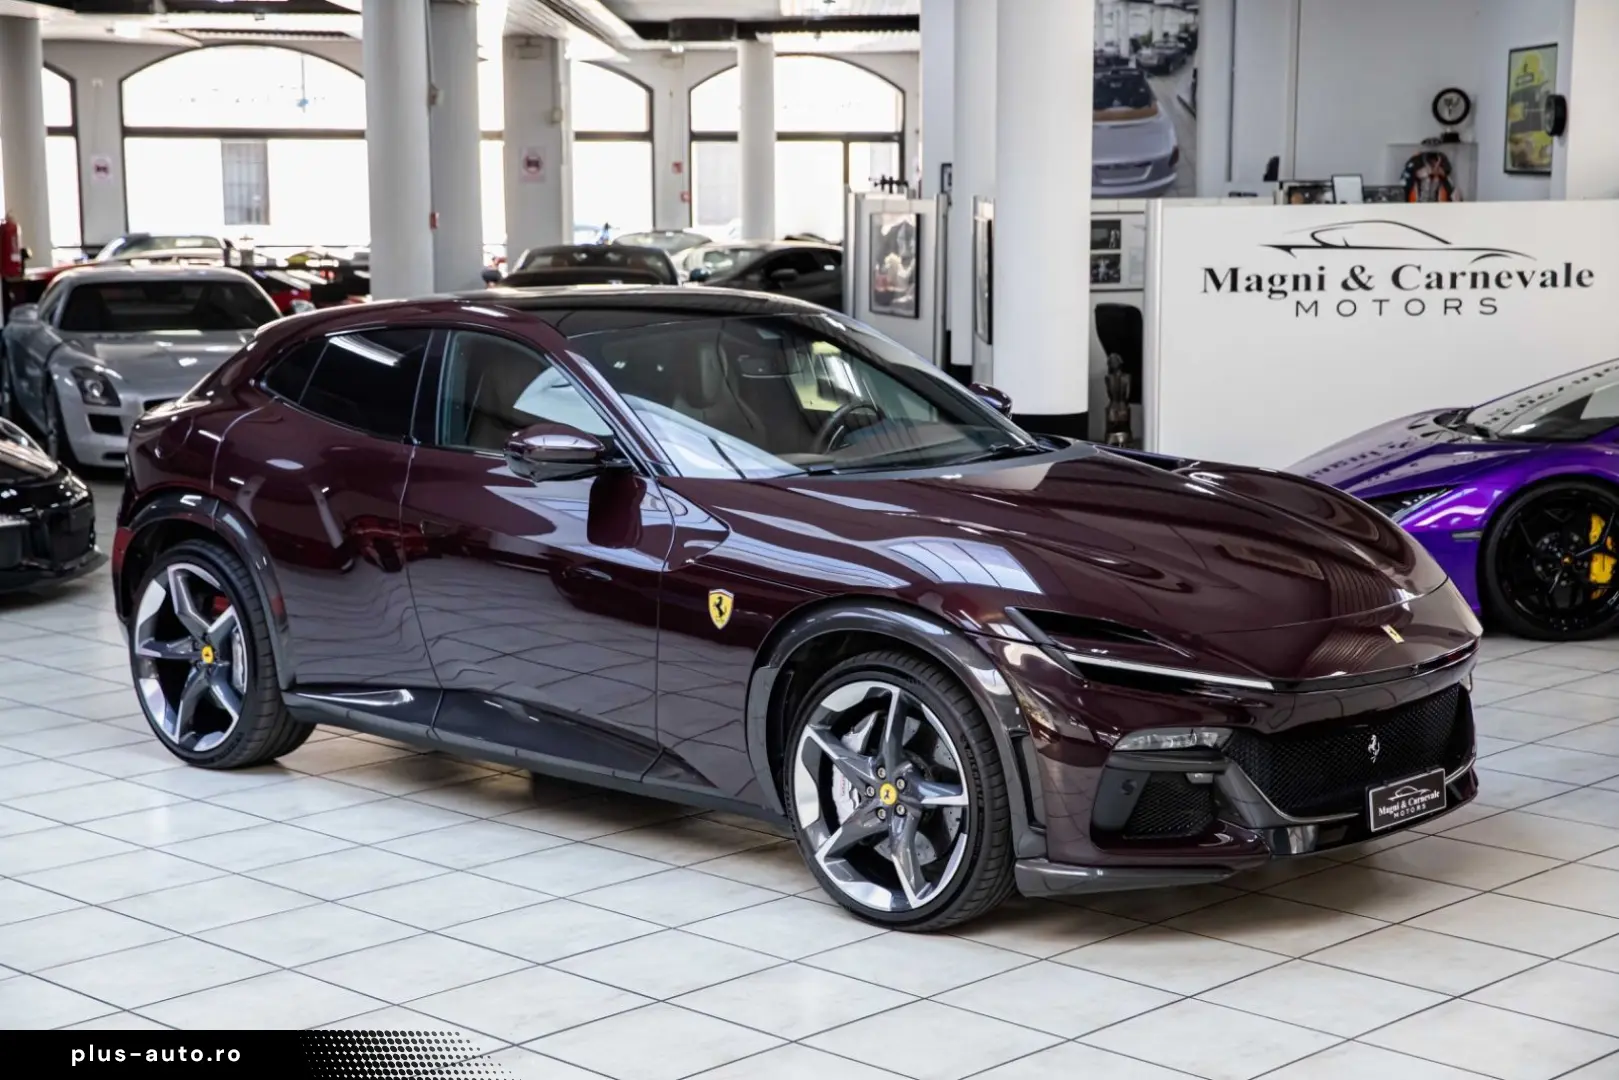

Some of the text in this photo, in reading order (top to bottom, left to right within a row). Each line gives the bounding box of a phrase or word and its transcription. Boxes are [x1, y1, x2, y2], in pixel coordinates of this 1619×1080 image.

[1202, 261, 1595, 301] Magni & Carnevale
[1295, 296, 1498, 318] MOTORS
[1378, 802, 1400, 816] Magni
[1393, 803, 1427, 818] MOTORS
